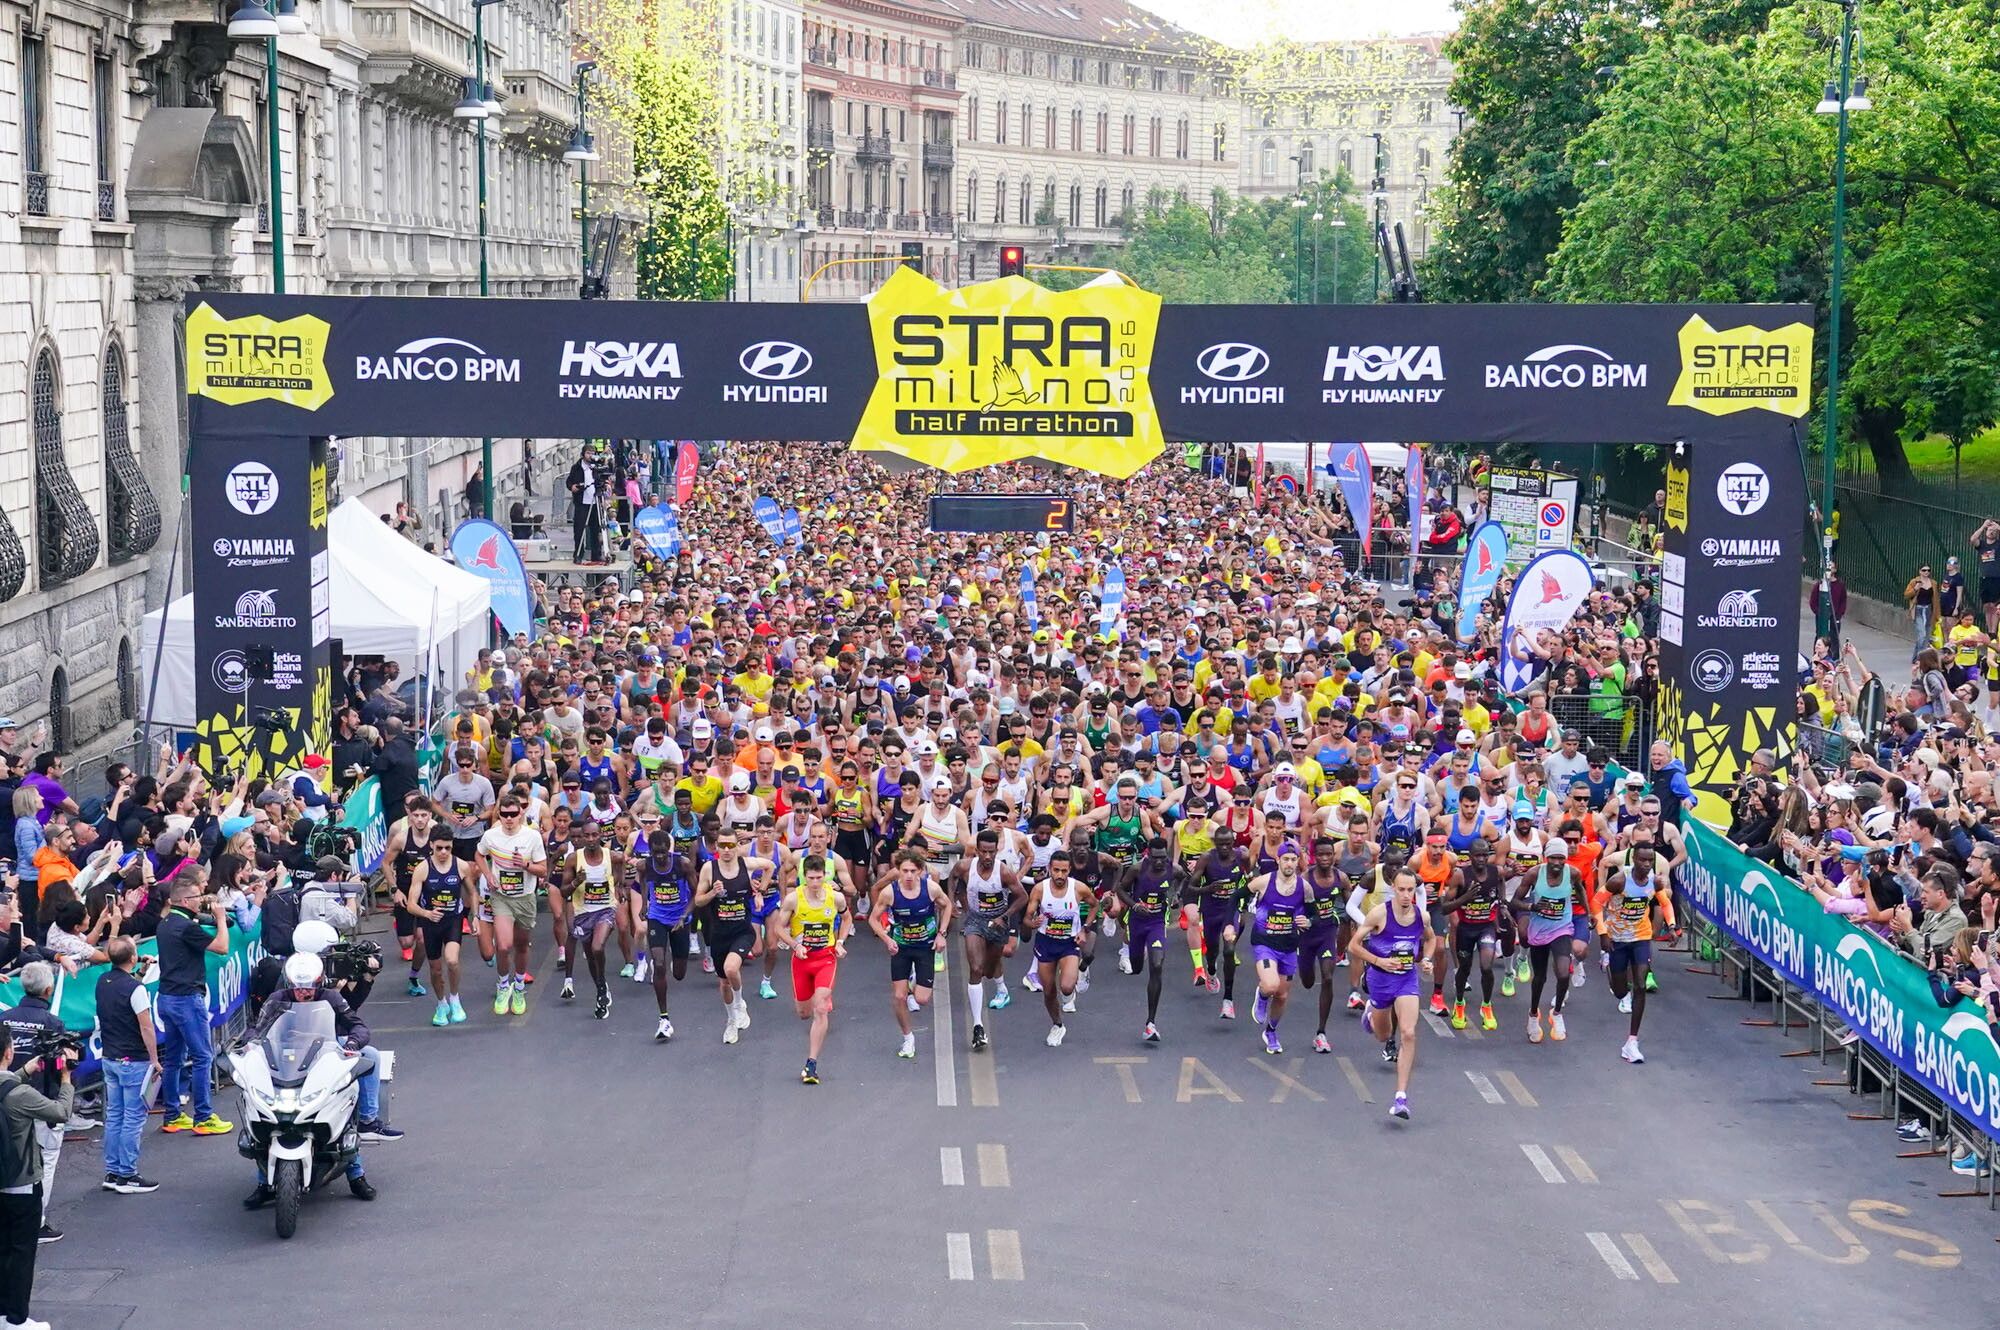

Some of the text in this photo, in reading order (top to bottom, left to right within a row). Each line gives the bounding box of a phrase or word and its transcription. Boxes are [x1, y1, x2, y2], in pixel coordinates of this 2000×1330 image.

[205, 333, 301, 359] STRA
[894, 315, 1111, 367] STRA
[206, 358, 302, 376] milno
[305, 337, 313, 376] 2026
[560, 341, 681, 378] HOKA
[1120, 320, 1137, 403] 2026
[1323, 346, 1446, 381] HOKA
[1693, 345, 1789, 368] STRA
[356, 356, 520, 383] BANCO BPM
[1485, 363, 1647, 388] BANCO BPM
[1694, 369, 1789, 384] milno
[212, 377, 307, 389] half marathon
[559, 383, 682, 400] FLY HUMAN FLY
[723, 384, 828, 403] HYUNDAI
[895, 369, 1111, 406] milno
[1699, 388, 1792, 398] half marathon
[1180, 386, 1285, 404] HYUNDAI
[1322, 388, 1445, 403] FLY HUMAN FLY
[910, 413, 1119, 433] half marathon
[235, 476, 269, 490] RTL
[1727, 476, 1760, 491] RTL
[236, 490, 270, 501] 102.5
[1727, 491, 1760, 501] 102.5
[1047, 500, 1068, 529] 2
[232, 539, 295, 555] YAMAHA
[1719, 539, 1782, 556] YAMAHA
[273, 652, 301, 662] letica
[1742, 660, 1779, 671] italiana
[1743, 652, 1779, 662] atletica
[361, 812, 387, 869] BANCO
[295, 869, 317, 880] CREW
[1695, 862, 1717, 916] BPM
[1724, 883, 1805, 979] BANCO BPM
[218, 951, 242, 1014] BPM
[1815, 945, 1904, 1058] BANCO BPM
[1915, 1021, 1985, 1116] BANCO
[1094, 1057, 1376, 1104] TAXI
[1658, 1199, 1963, 1268] BUS
